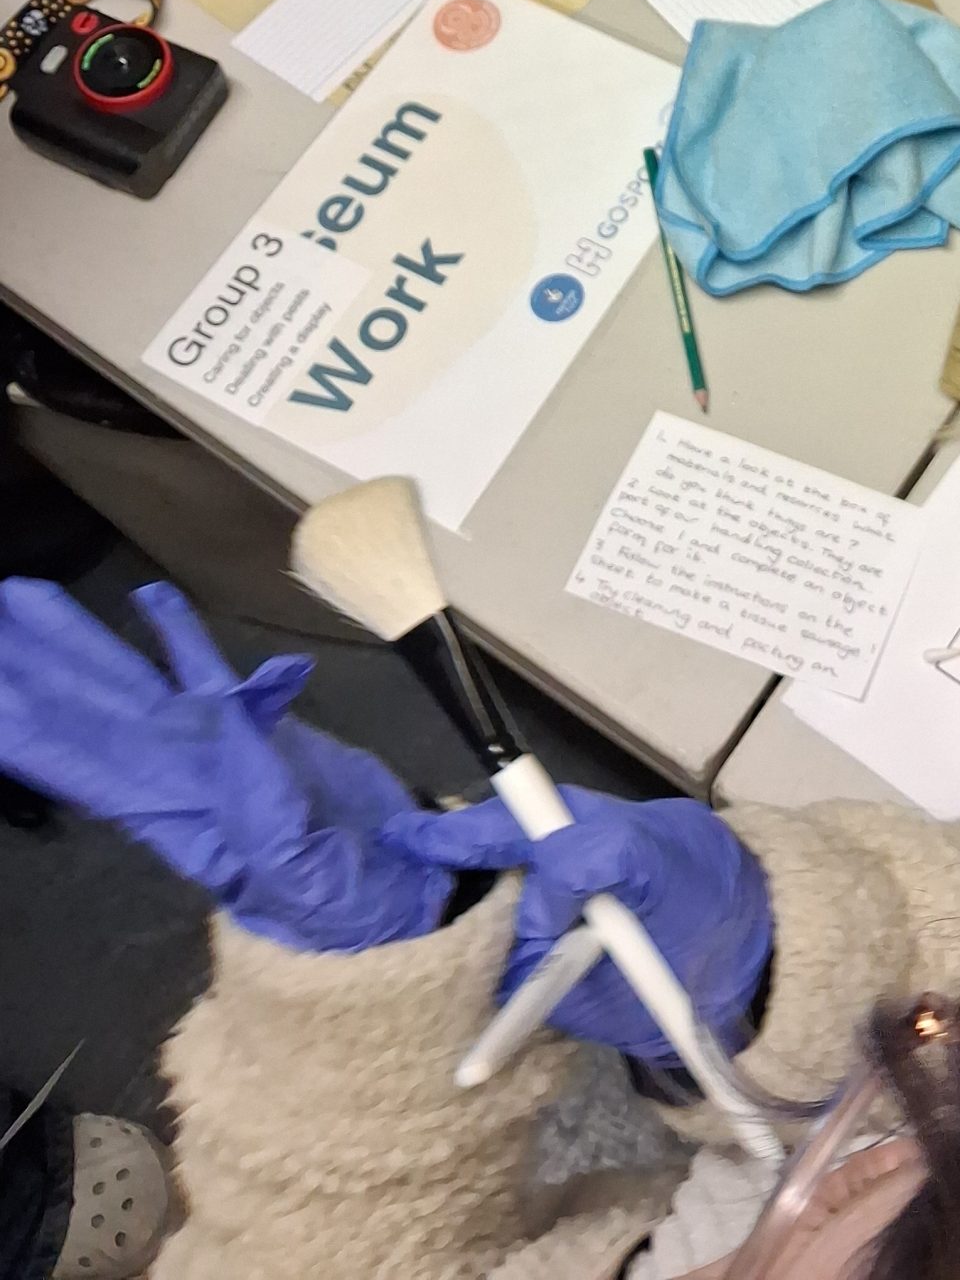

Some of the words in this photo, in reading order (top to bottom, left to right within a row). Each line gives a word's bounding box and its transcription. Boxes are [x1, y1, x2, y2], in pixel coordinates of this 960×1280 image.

[167, 263, 261, 368] Group
[250, 231, 284, 258] 3
[203, 342, 241, 384] Caring
[234, 325, 251, 342] for
[250, 281, 286, 324] objects
[224, 348, 268, 395] Dealing
[263, 321, 286, 346] with
[282, 288, 311, 322] pests
[287, 236, 466, 412] Work
[247, 355, 294, 407] Creating
[289, 344, 300, 355] a
[297, 302, 333, 344] display
